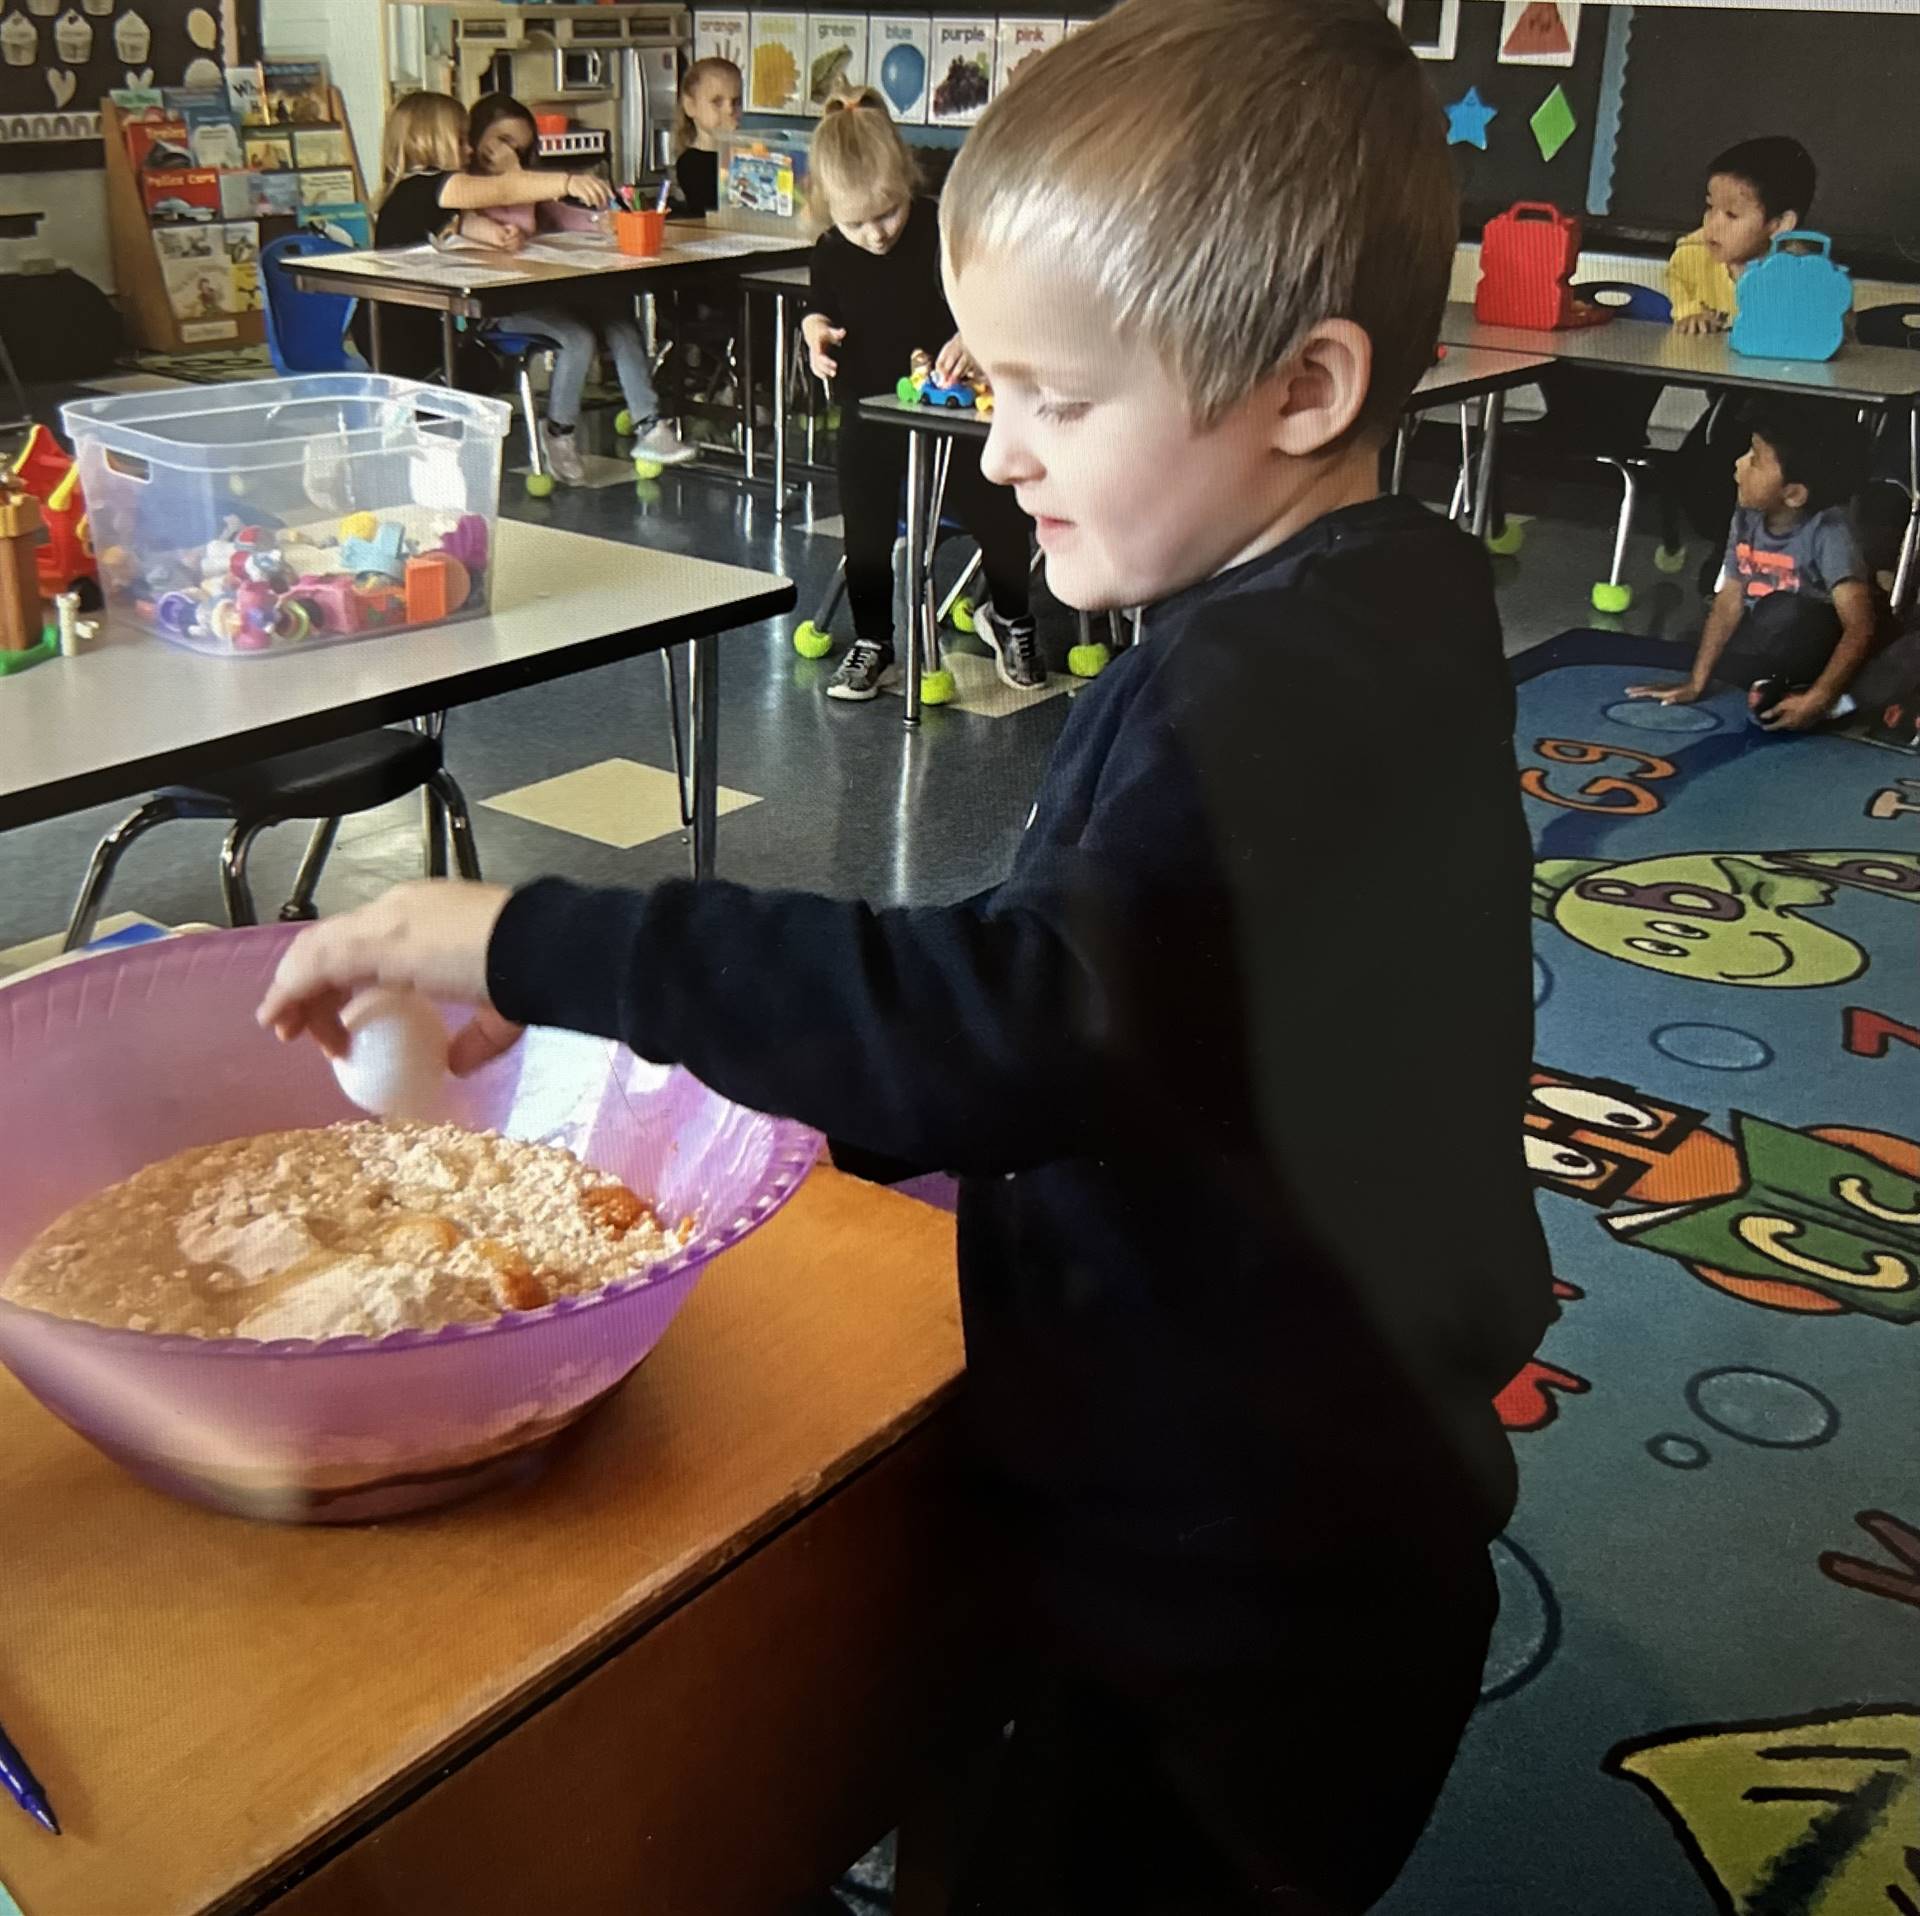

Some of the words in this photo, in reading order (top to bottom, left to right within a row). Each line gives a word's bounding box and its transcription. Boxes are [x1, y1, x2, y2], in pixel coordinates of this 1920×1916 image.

[700, 20, 742, 36] orange
[817, 24, 856, 39] green
[885, 24, 913, 39] blue
[941, 26, 985, 44] purple
[1015, 27, 1044, 44] pink
